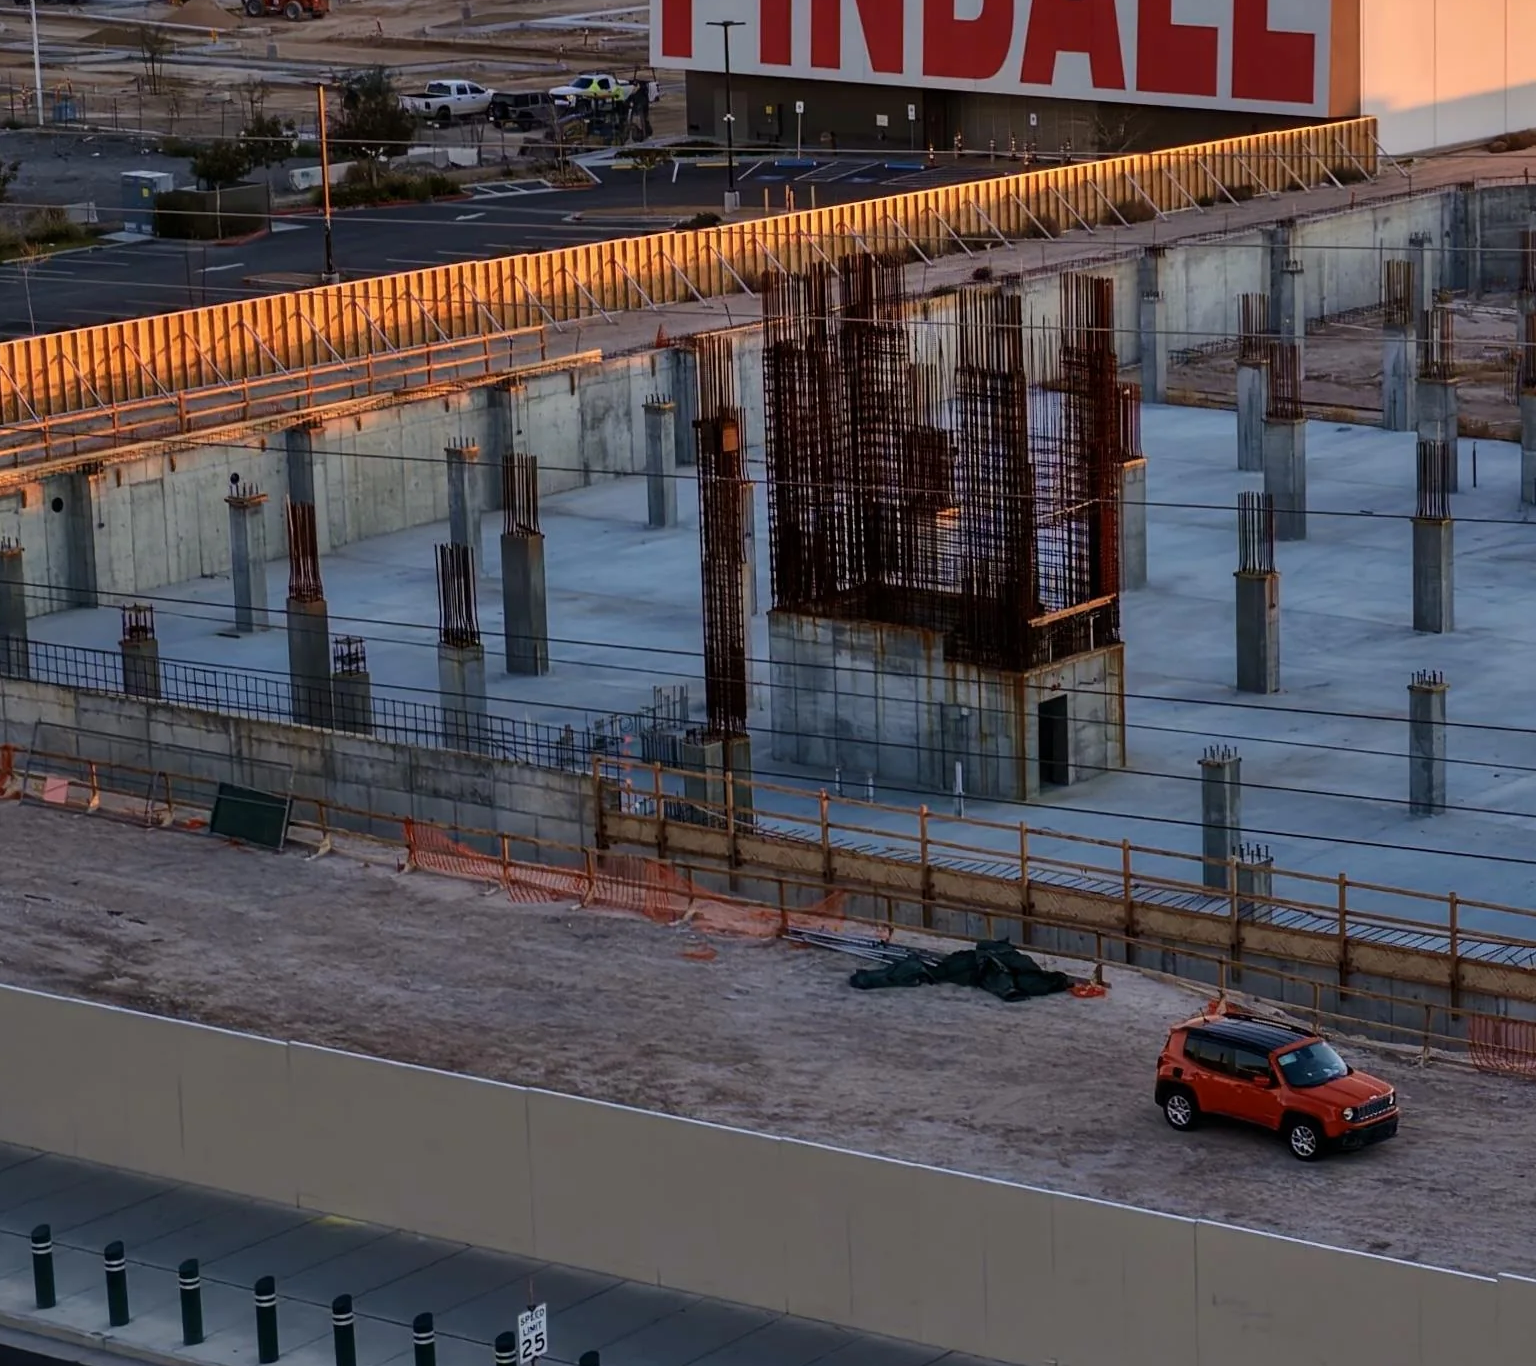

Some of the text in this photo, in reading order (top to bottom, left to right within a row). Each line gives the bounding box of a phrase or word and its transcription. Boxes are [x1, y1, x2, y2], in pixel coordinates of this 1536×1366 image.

[520, 1308, 545, 1327] SPEED
[522, 1320, 542, 1336] LIMIT
[521, 1332, 545, 1359] 25
